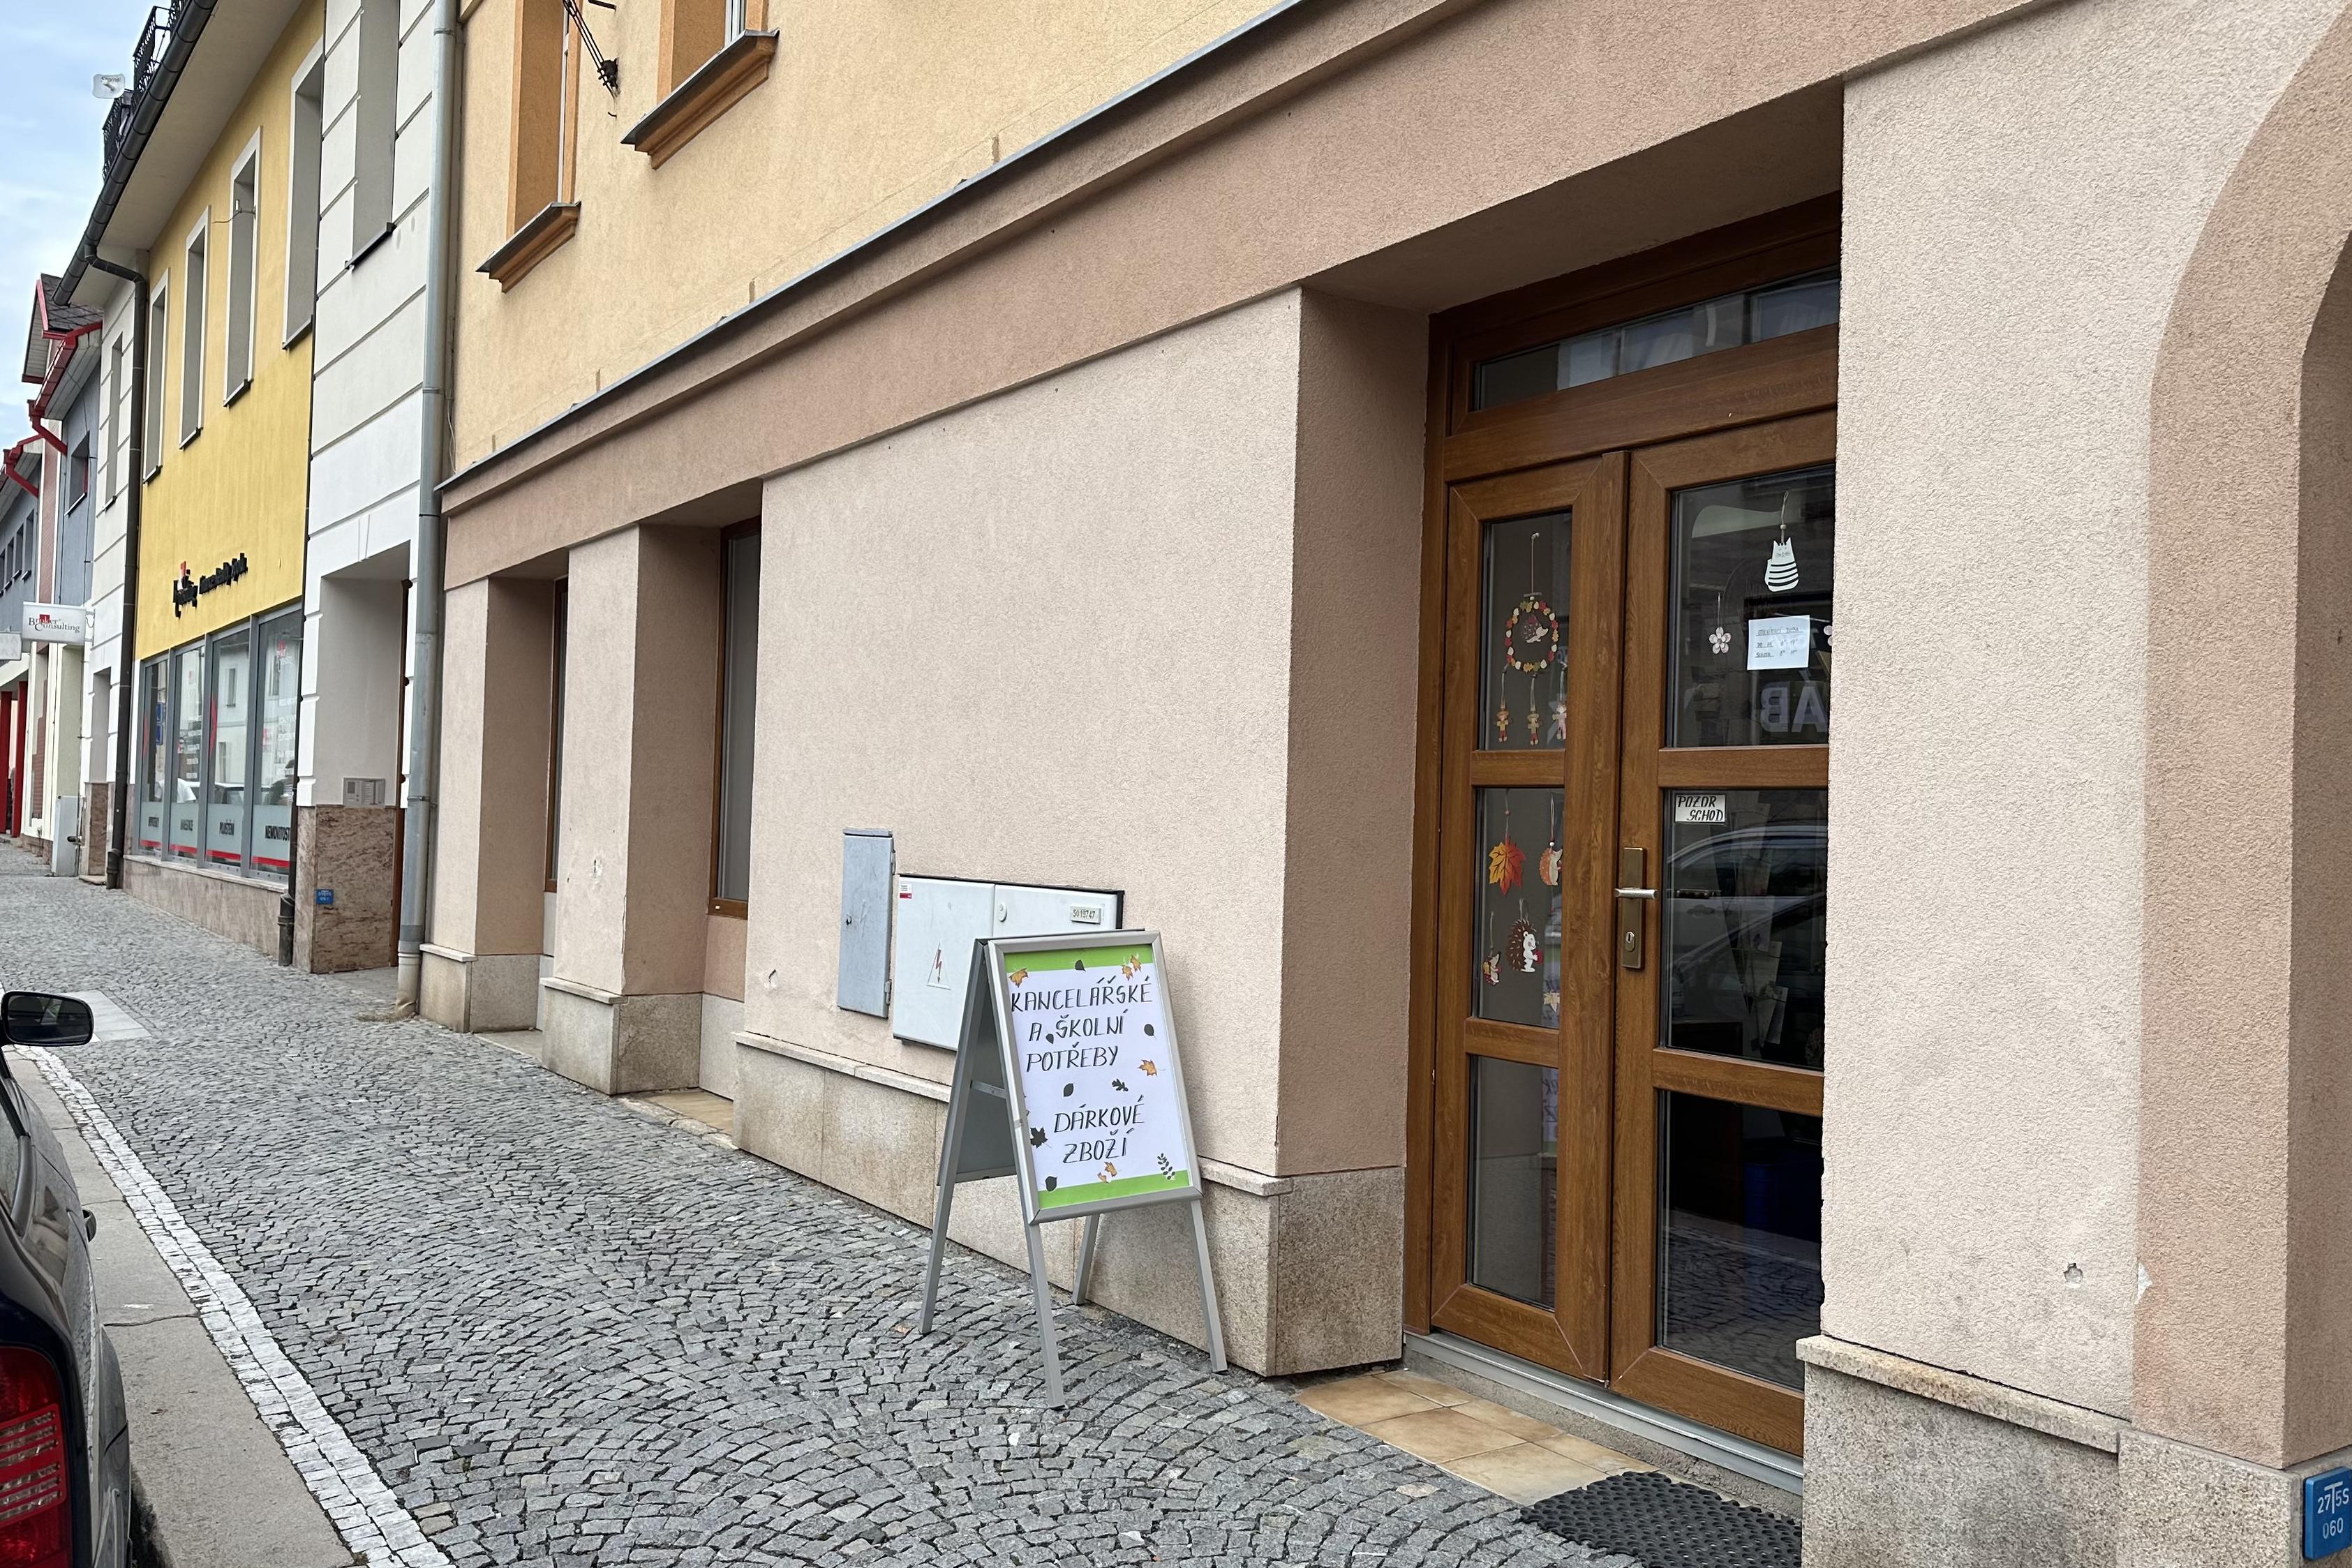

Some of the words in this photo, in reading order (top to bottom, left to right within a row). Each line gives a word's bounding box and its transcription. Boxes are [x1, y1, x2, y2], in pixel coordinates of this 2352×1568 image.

[34, 622, 80, 633] Consulting
[1677, 796, 1717, 807] POZOR
[1686, 809, 1724, 821] SCHOD
[265, 825, 291, 842] NEMOVITOST
[1011, 976, 1153, 1012] KANCELÁŘSKÉ
[1029, 1022, 1042, 1042] A
[1055, 1008, 1129, 1038] ŠKOLNÍ
[1026, 1042, 1119, 1073] POTŘEBY
[1054, 1094, 1145, 1133] DÁRKOVÉ
[1062, 1127, 1135, 1164] ZBOŽÍ
[2323, 1517, 2344, 1539] 060
